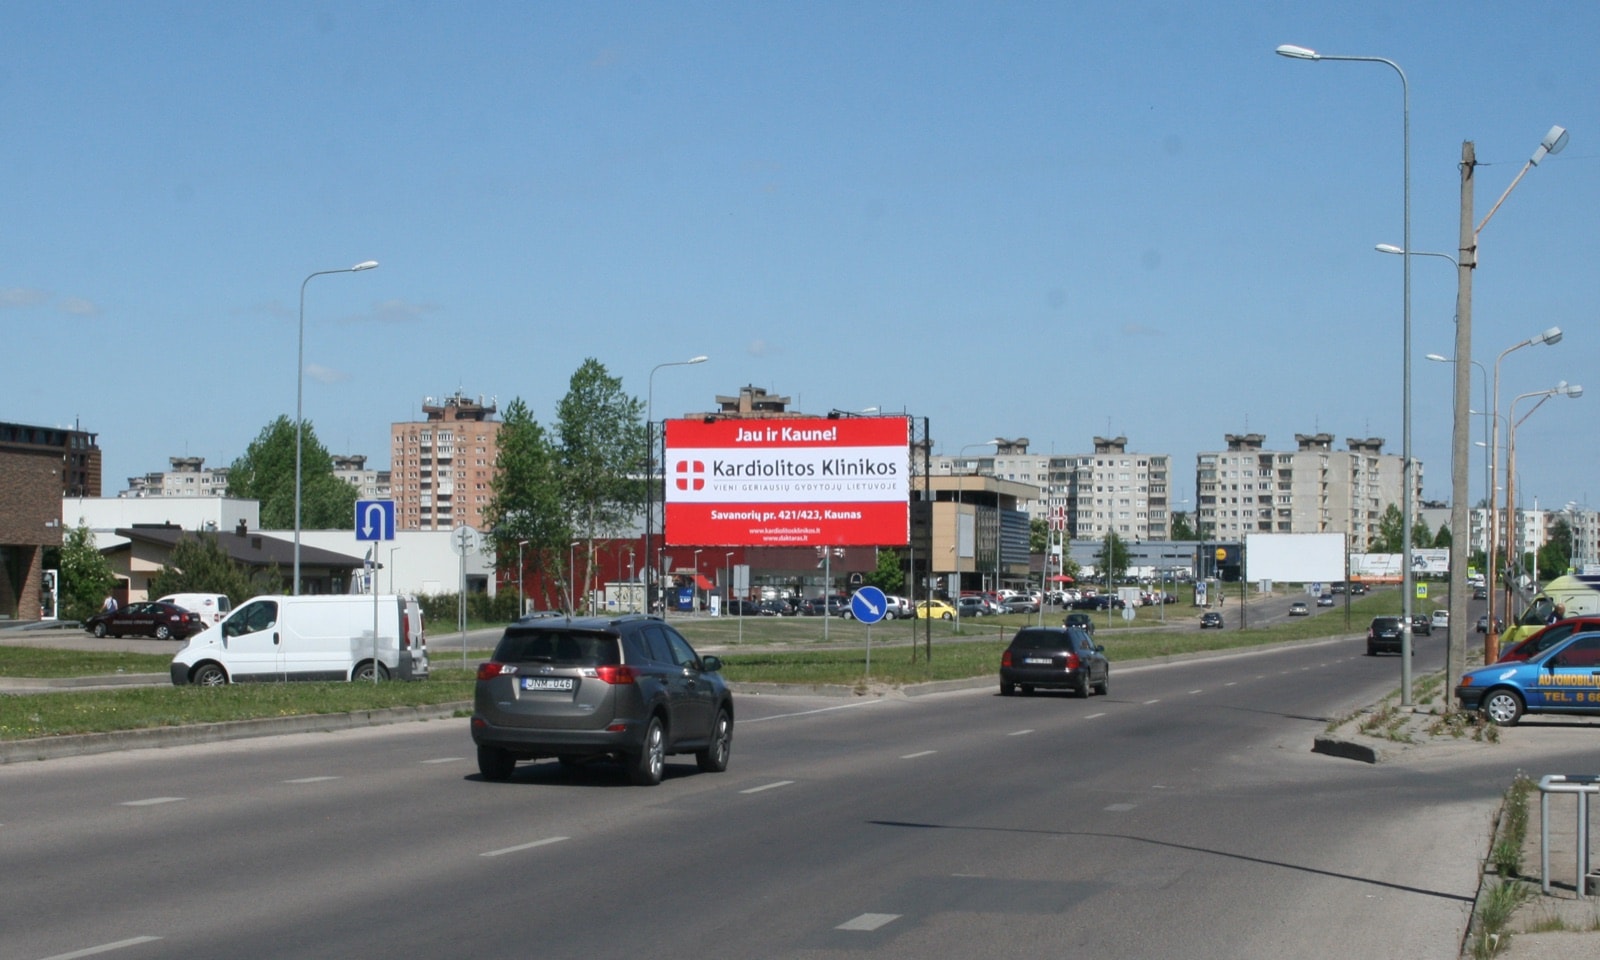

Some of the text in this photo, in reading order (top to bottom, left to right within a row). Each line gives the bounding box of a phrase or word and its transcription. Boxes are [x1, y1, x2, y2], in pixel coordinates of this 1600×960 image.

[736, 426, 837, 442] Jau ir Kaune!
[713, 458, 897, 477] Kardiolitos Klinikos
[742, 484, 790, 492] GERIAUSIŲ
[847, 482, 897, 490] LIETUVOJE
[711, 509, 862, 522] Savanorių pr. 421/423, Kaunas
[1544, 692, 1573, 702] TEL.
[1576, 692, 1585, 702] 8
